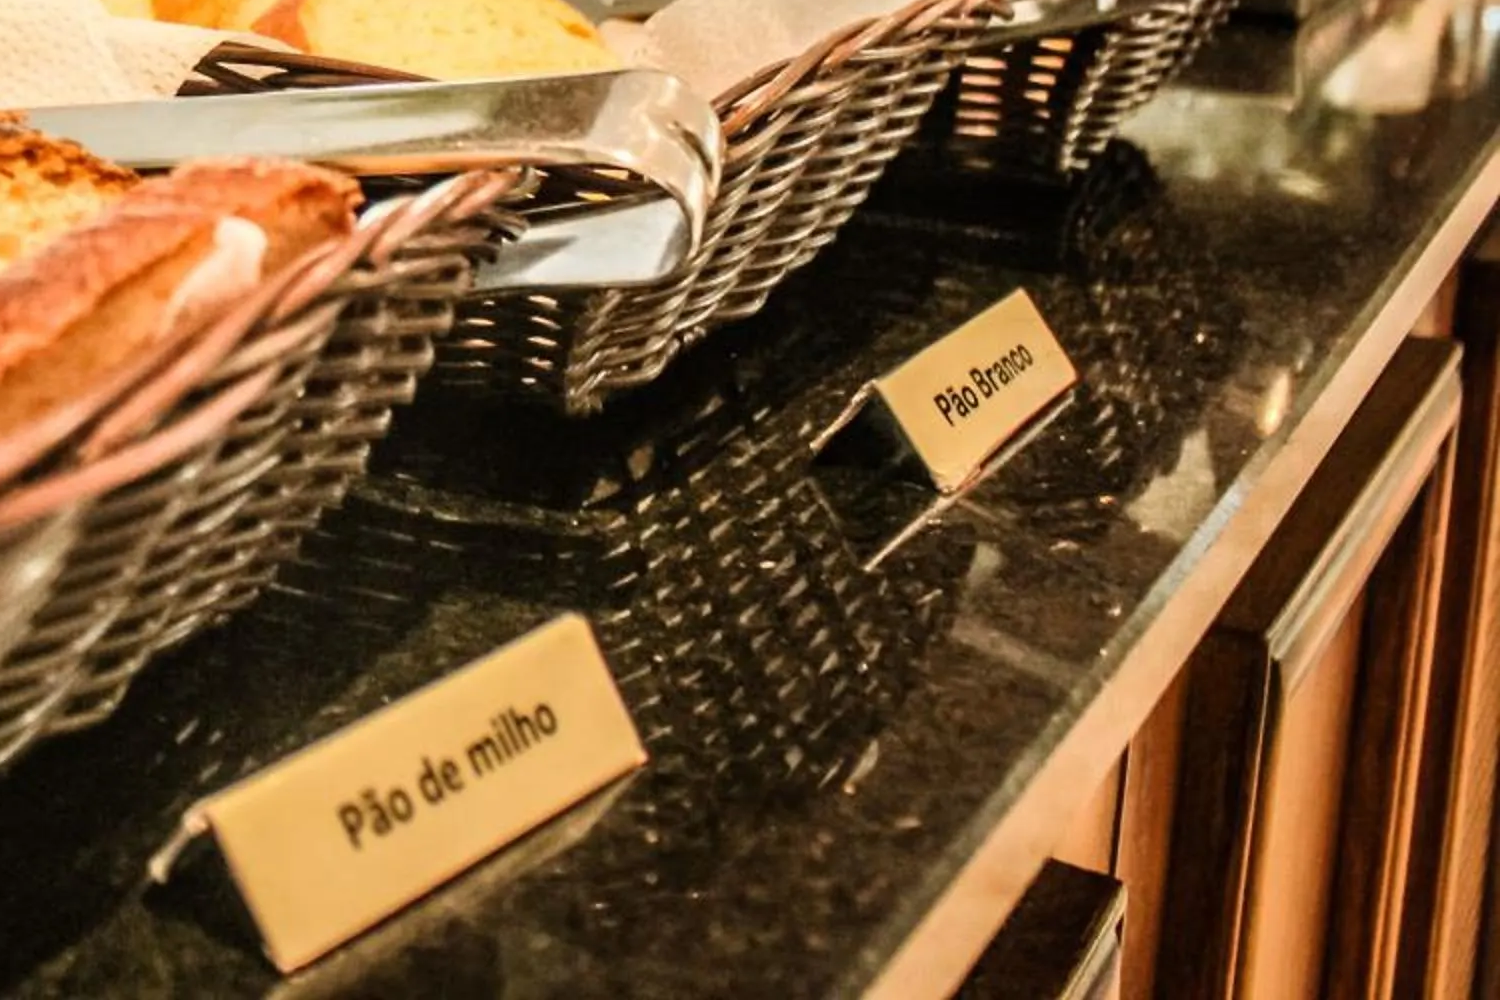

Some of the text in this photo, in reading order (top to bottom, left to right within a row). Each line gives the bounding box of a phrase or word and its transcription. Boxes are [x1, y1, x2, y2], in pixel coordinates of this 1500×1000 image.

[933, 344, 1033, 427] Pão Branco
[337, 702, 558, 850] Pão de milho
